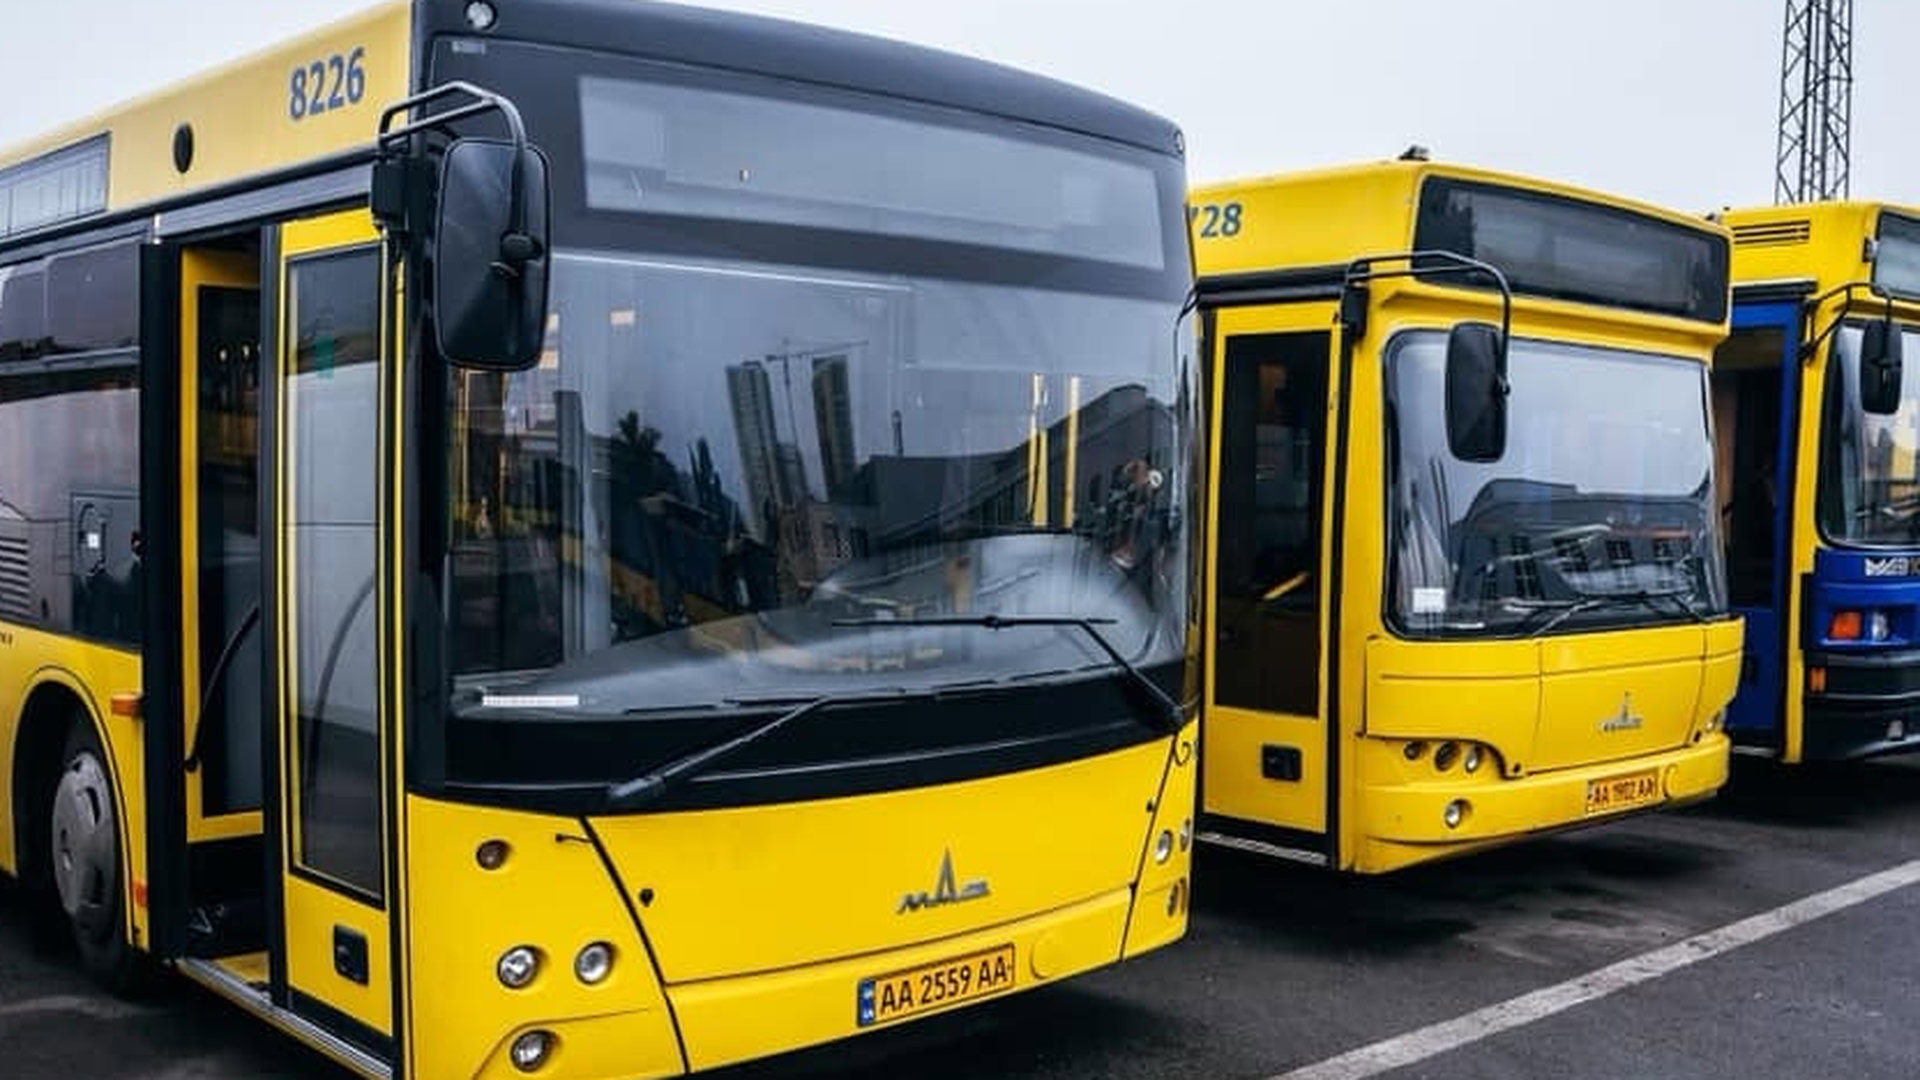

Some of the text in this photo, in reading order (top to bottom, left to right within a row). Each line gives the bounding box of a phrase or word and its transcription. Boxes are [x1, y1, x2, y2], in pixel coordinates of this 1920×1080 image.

[290, 46, 365, 120] 8226
[880, 956, 1008, 1015] AA 2559 AA
